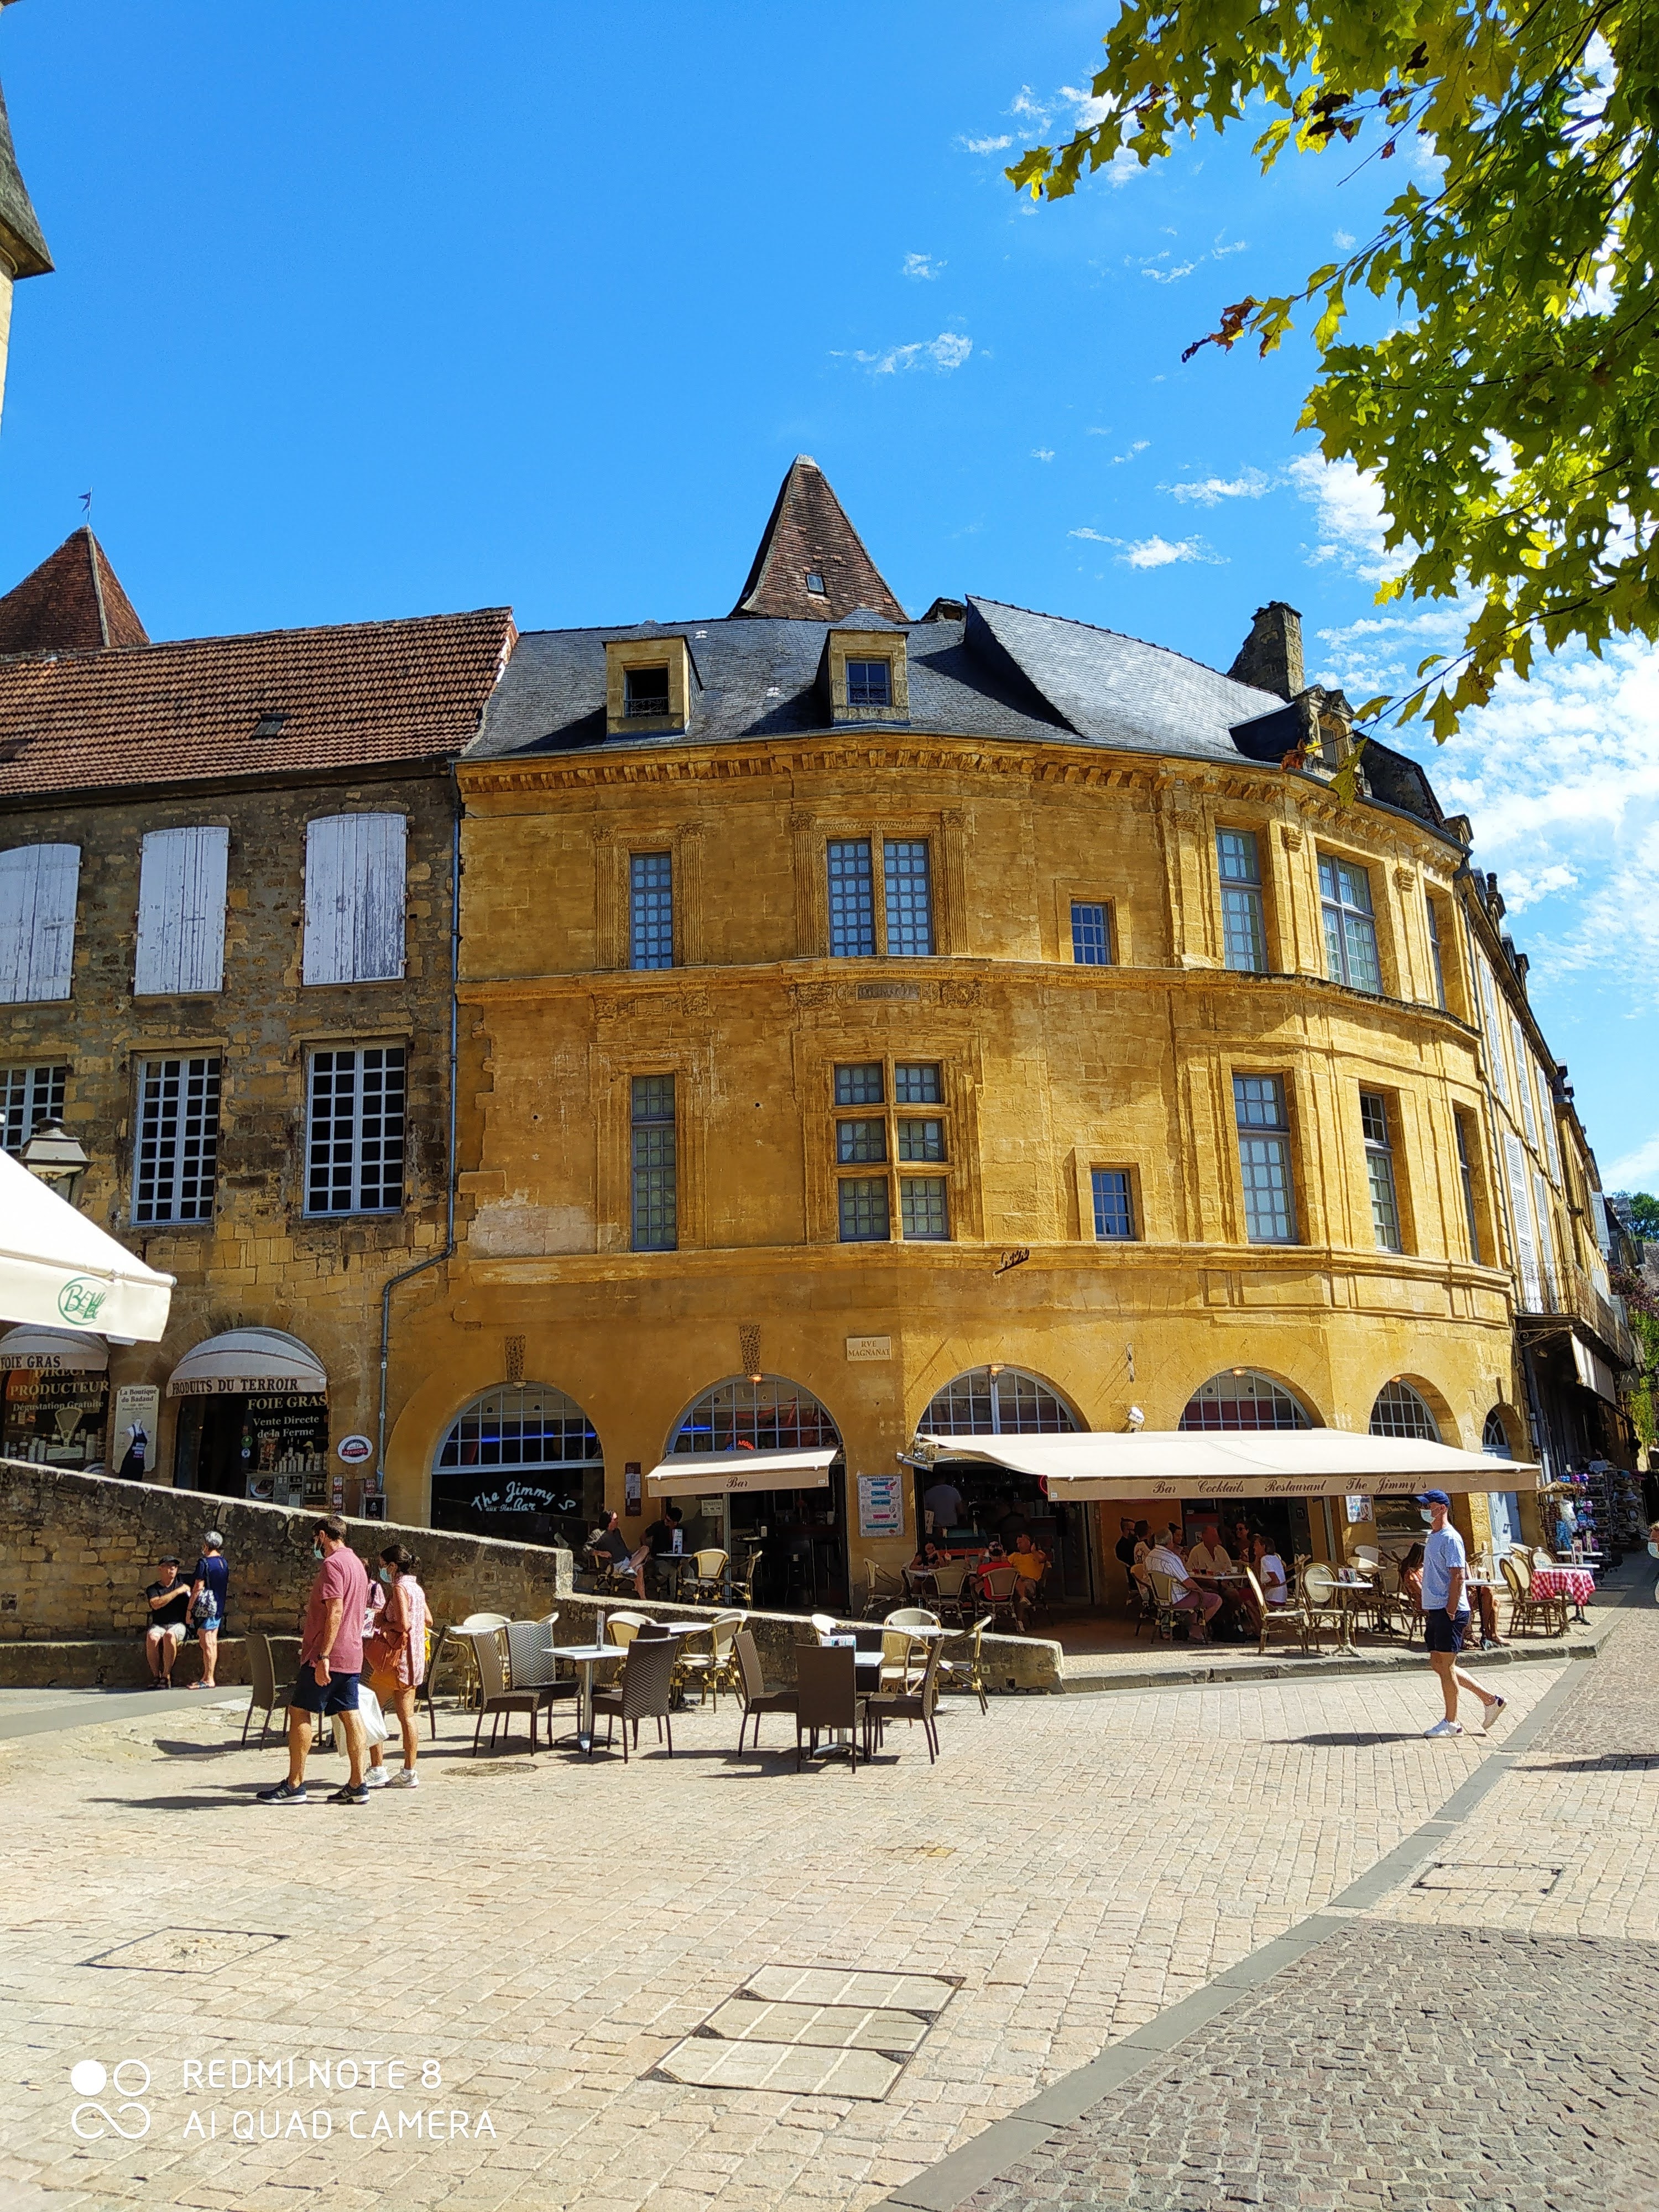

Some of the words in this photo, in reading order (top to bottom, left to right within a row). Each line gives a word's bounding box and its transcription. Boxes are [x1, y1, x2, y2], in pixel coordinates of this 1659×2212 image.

[848, 1348, 890, 1357] MAGNANAT
[1, 1356, 22, 1369] FOIE
[27, 1355, 61, 1368] GRAS
[11, 1380, 109, 1396] PRODUCTEUR
[172, 1379, 213, 1395] PRODUITS
[218, 1379, 234, 1392] DU
[241, 1378, 299, 1391] TERROIR
[248, 1397, 283, 1410] FOIE
[286, 1395, 327, 1408] GRAS
[253, 1416, 281, 1426] Vente
[284, 1415, 320, 1425] Directe
[283, 1428, 315, 1437] Ferme
[726, 1476, 748, 1488] Bar
[1152, 1480, 1176, 1493] Bar
[1197, 1480, 1244, 1493] Cocktails
[1264, 1479, 1327, 1493] Restaurant
[1345, 1477, 1368, 1490] The
[1375, 1476, 1427, 1493] Jimmy's
[471, 1491, 499, 1512] The
